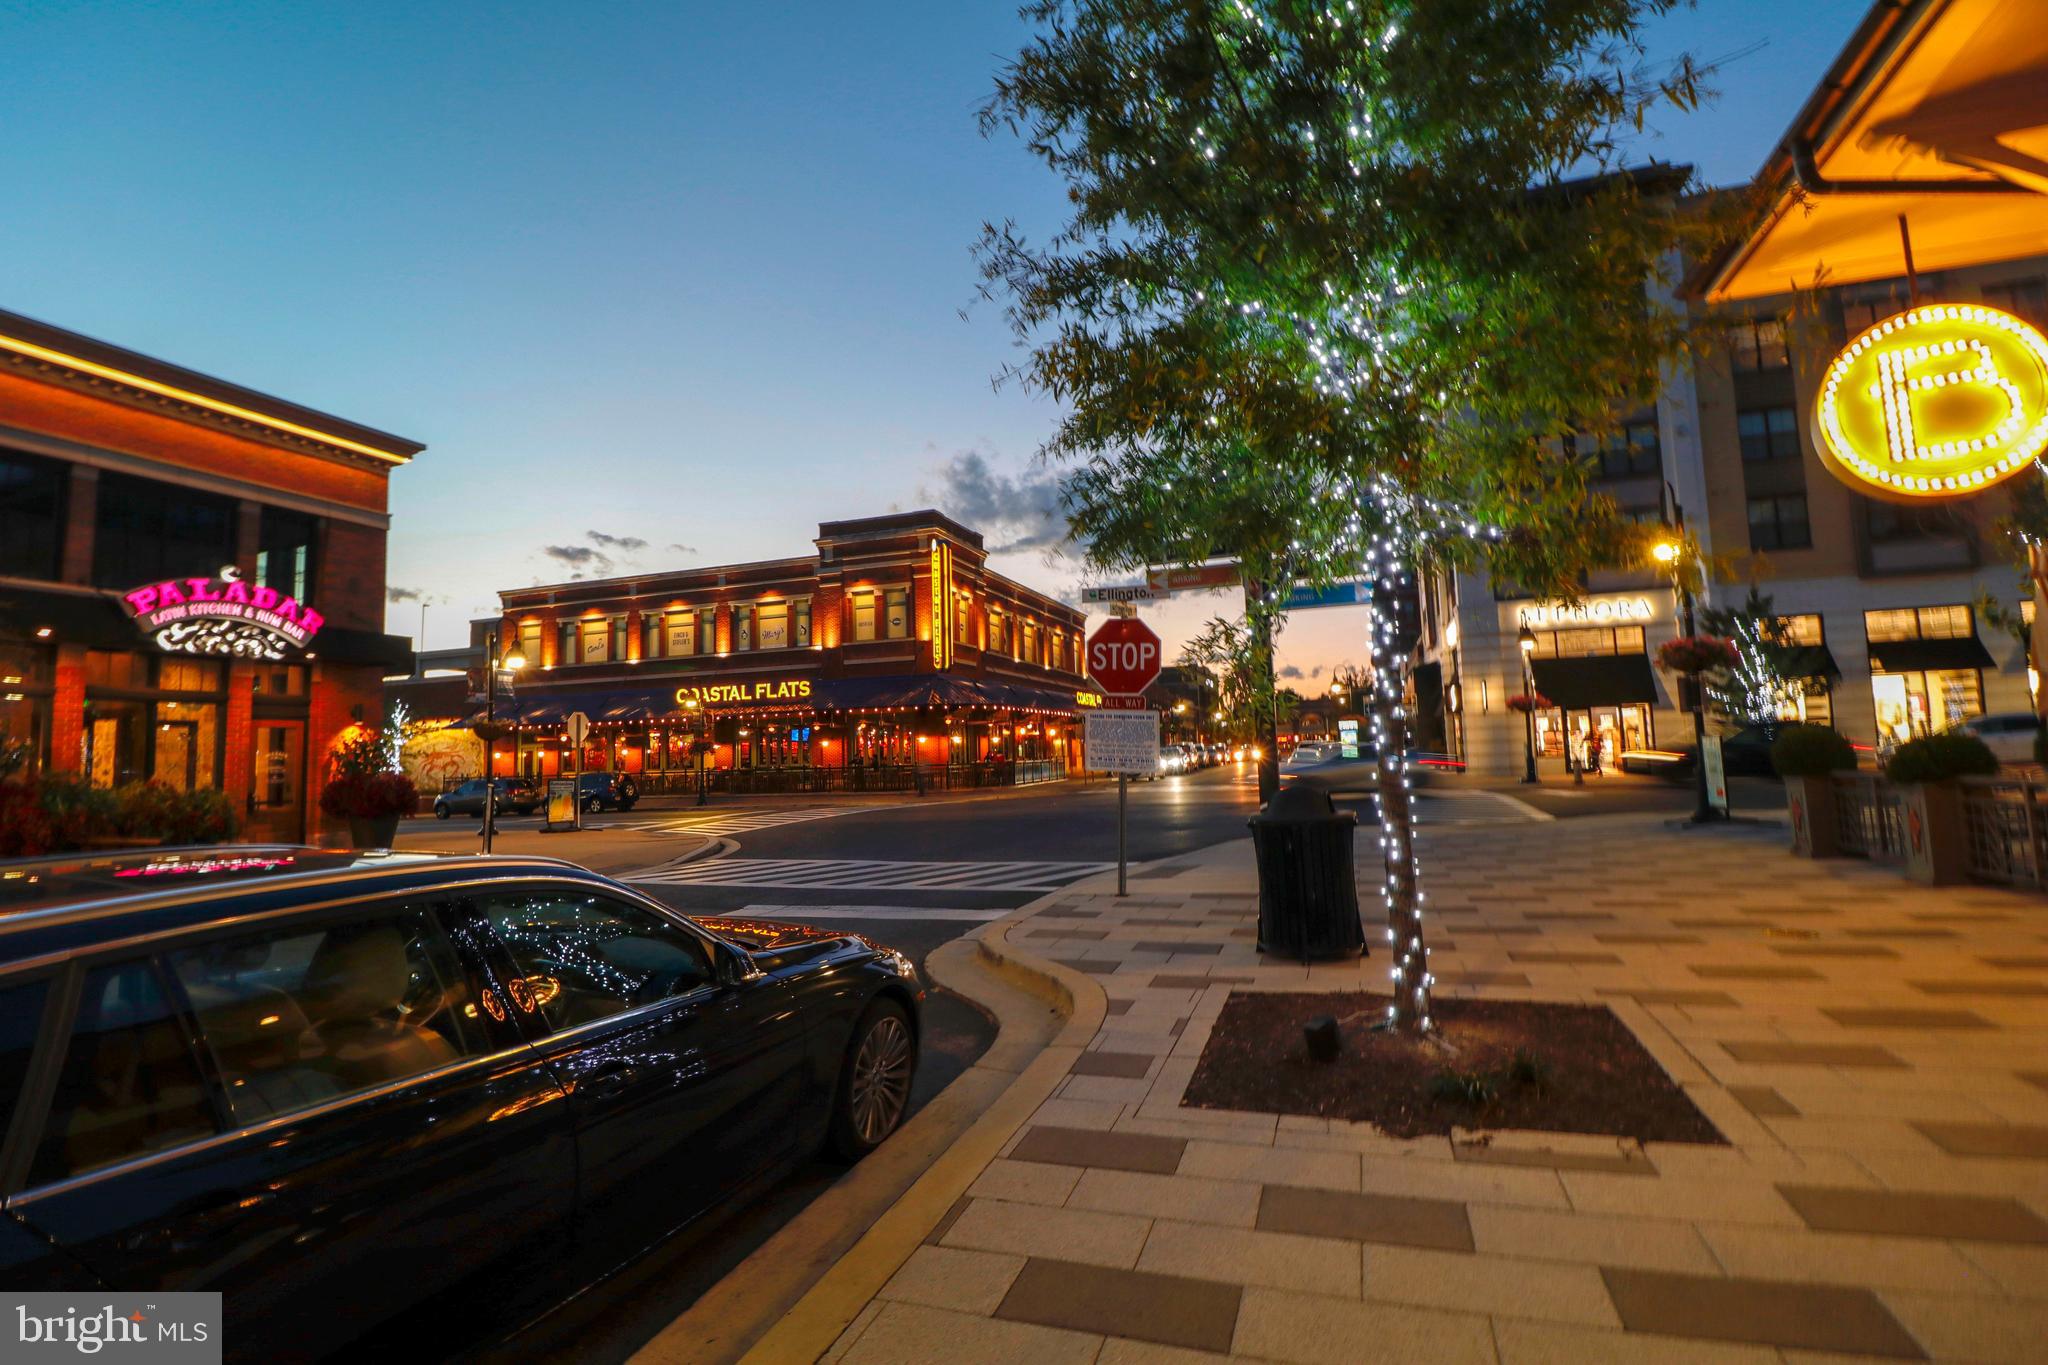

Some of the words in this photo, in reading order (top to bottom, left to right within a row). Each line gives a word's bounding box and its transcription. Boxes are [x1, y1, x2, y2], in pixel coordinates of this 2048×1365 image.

[126, 578, 325, 635] PALADAR
[151, 605, 187, 626] LATIN
[188, 602, 242, 617] KITCHEN
[244, 606, 254, 618] &
[255, 609, 283, 628] RUM
[282, 620, 306, 640] BAR
[1092, 642, 1156, 671] STOP
[755, 680, 811, 700] FLATS
[1104, 698, 1120, 708] ALL
[1125, 698, 1141, 708] WAY
